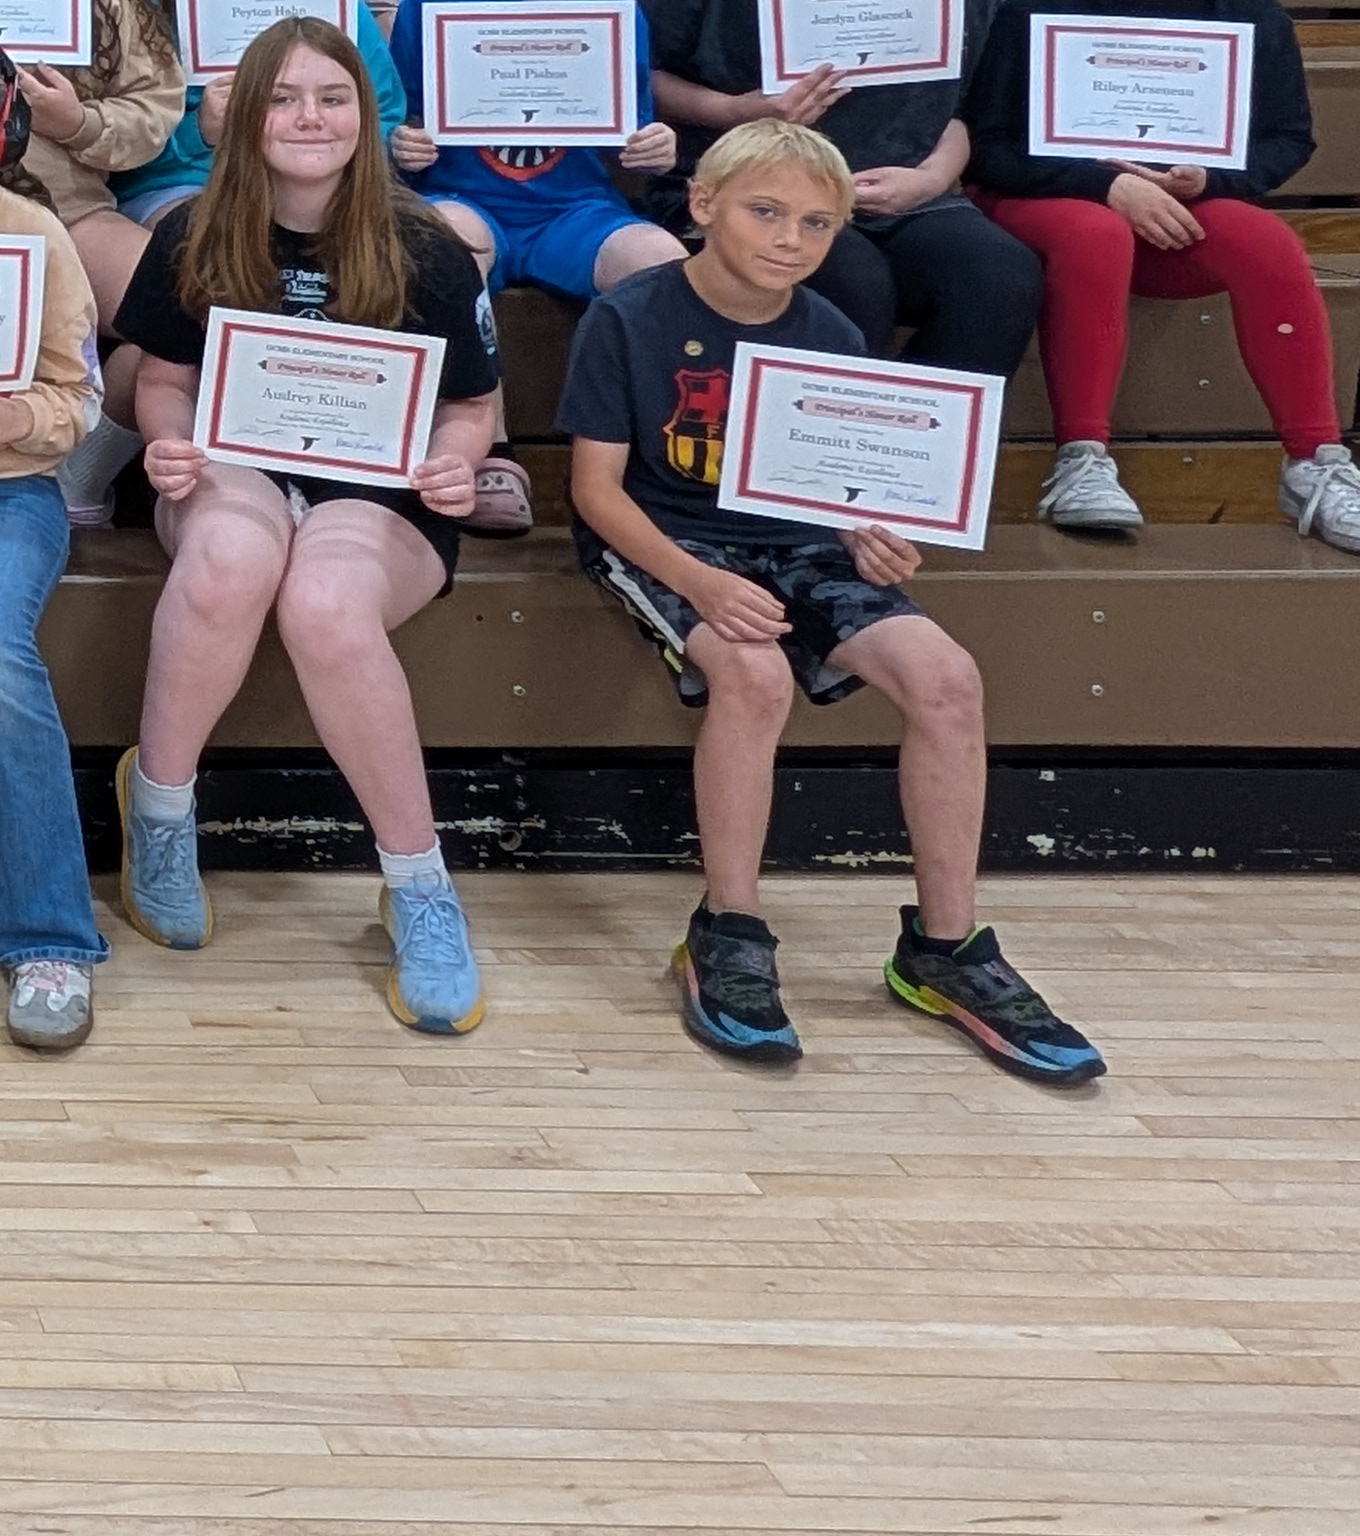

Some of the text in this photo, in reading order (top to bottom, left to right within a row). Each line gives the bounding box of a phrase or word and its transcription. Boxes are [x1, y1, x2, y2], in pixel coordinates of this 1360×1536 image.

[231, 4, 305, 19] Peyton Hahn
[1092, 81, 1127, 93] Riley
[261, 386, 367, 410] Audrey Killian
[787, 428, 930, 461] Emmitt Swanson
